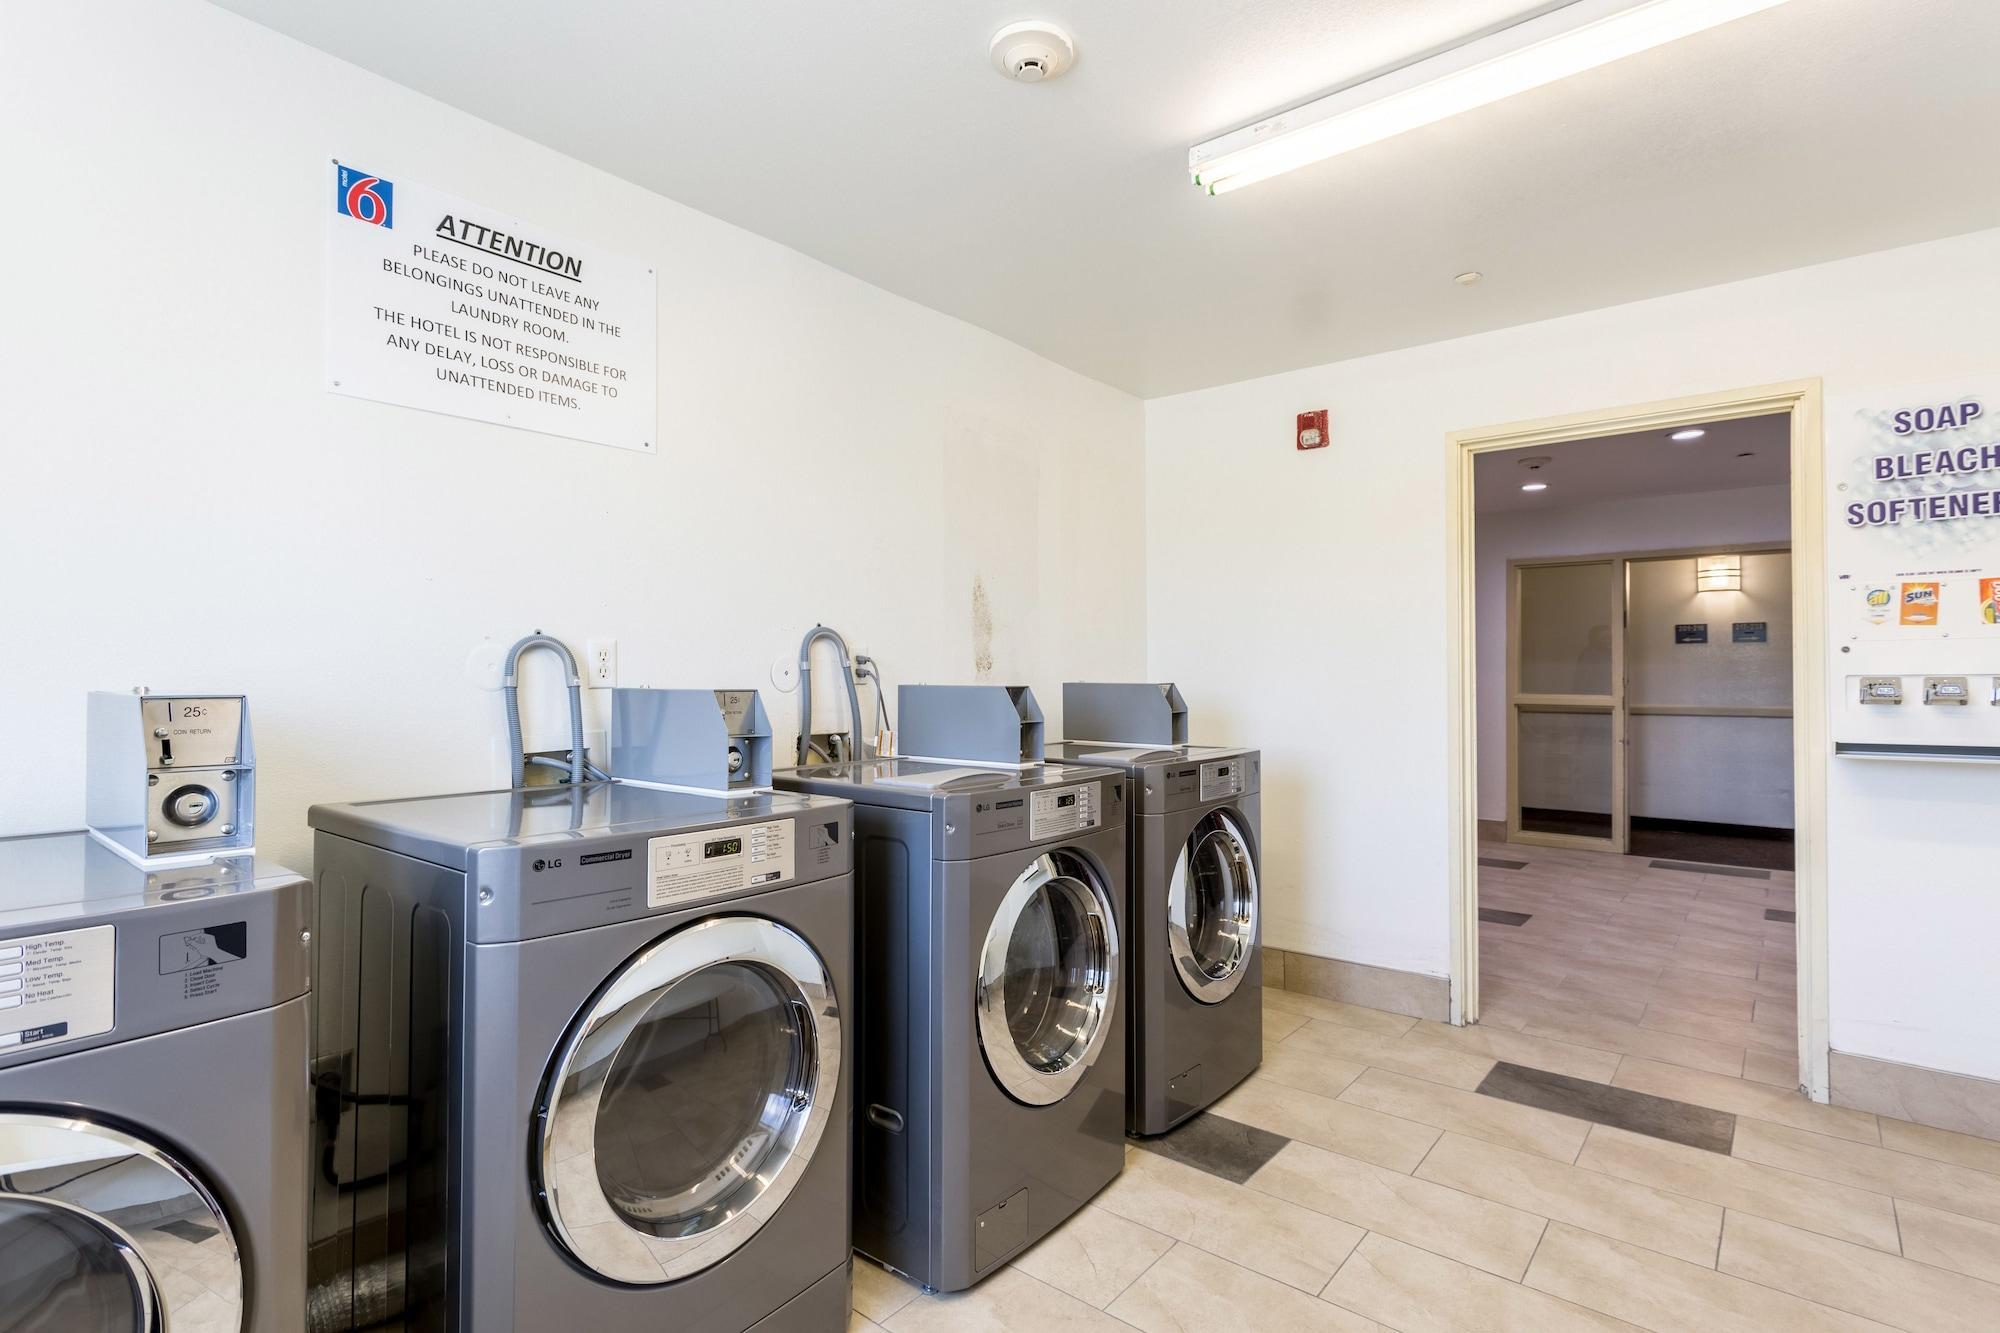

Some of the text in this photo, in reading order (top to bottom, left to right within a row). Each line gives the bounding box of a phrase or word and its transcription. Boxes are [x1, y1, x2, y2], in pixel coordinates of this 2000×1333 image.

[346, 177, 387, 226] 6
[436, 214, 582, 278] ATTENTION
[413, 244, 600, 311] PLEASE DO NOT LEAVE ANY
[383, 259, 621, 337] BELONGINGS UNATTENDED IN THE
[451, 300, 569, 343] LAUNDRY ROOM.
[373, 306, 627, 381] THE HOTEL IS NOT RESPONSIBLE FOR
[386, 334, 618, 398] ANY DELAY, LOSS OR DAMAGE TO
[436, 368, 581, 410] UNATTENDED ITEMS.
[1893, 402, 1980, 434] SOAP
[1874, 445, 2000, 480] BLEACH
[1905, 590, 1933, 603] SUN
[547, 850, 631, 869] LG Commercial Dryer
[25, 943, 42, 951] High
[25, 959, 42, 967] Med
[44, 956, 64, 964] Temp
[36, 989, 54, 998] Heat
[43, 972, 63, 980] Temp
[24, 1027, 45, 1038] Start
